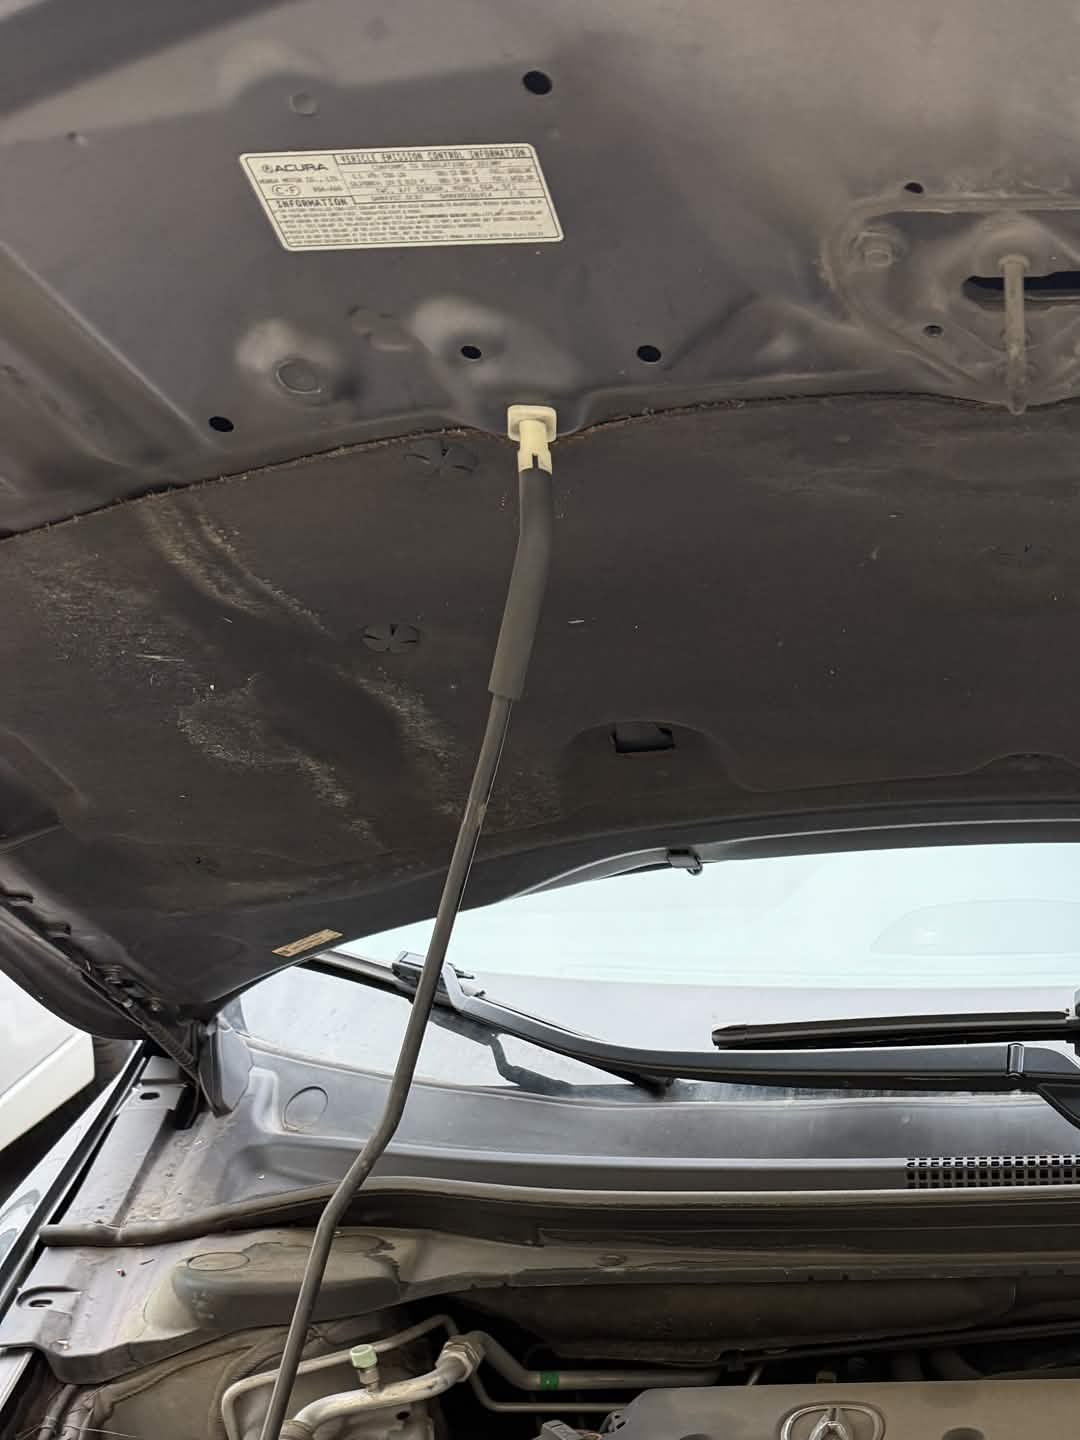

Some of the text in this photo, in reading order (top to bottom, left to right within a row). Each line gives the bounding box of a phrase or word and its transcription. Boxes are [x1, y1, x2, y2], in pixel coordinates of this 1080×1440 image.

[340, 147, 525, 163] VEHICLE EMISSION CONTROL INFORMATION
[274, 163, 328, 172] ACURA
[276, 198, 348, 208] INFORMATION
